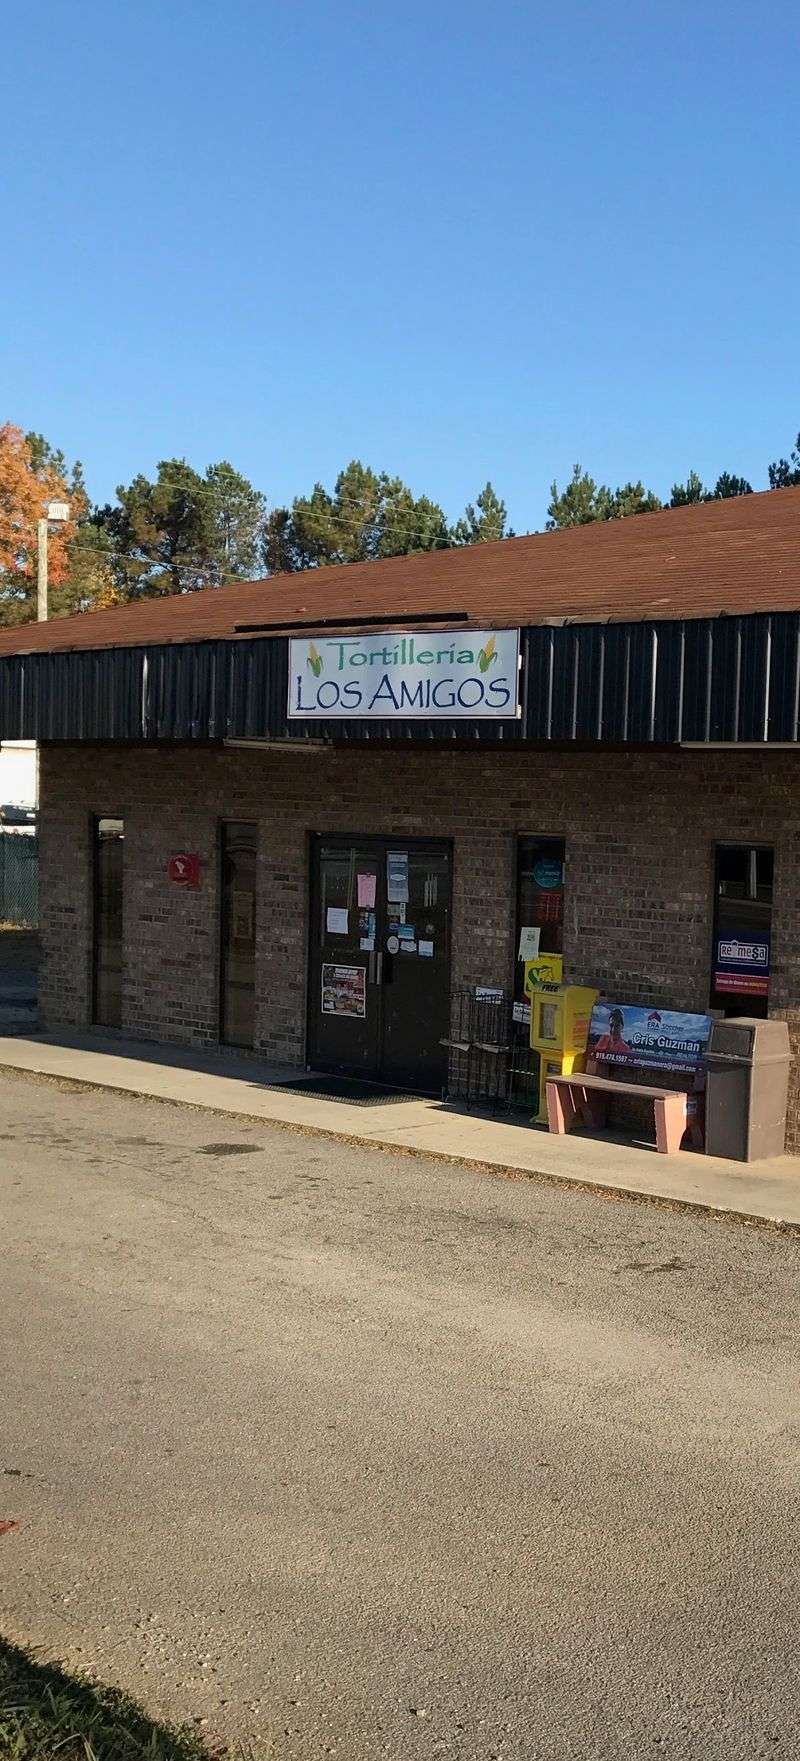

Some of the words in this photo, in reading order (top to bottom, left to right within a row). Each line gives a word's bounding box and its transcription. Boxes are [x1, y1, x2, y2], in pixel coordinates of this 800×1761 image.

[326, 638, 475, 671] Tortilleria
[295, 674, 363, 711] LOS
[367, 673, 511, 710] AMIGOS
[647, 1021, 660, 1031] ERA
[633, 1032, 654, 1046] Cris
[657, 1034, 700, 1052] Guzman
